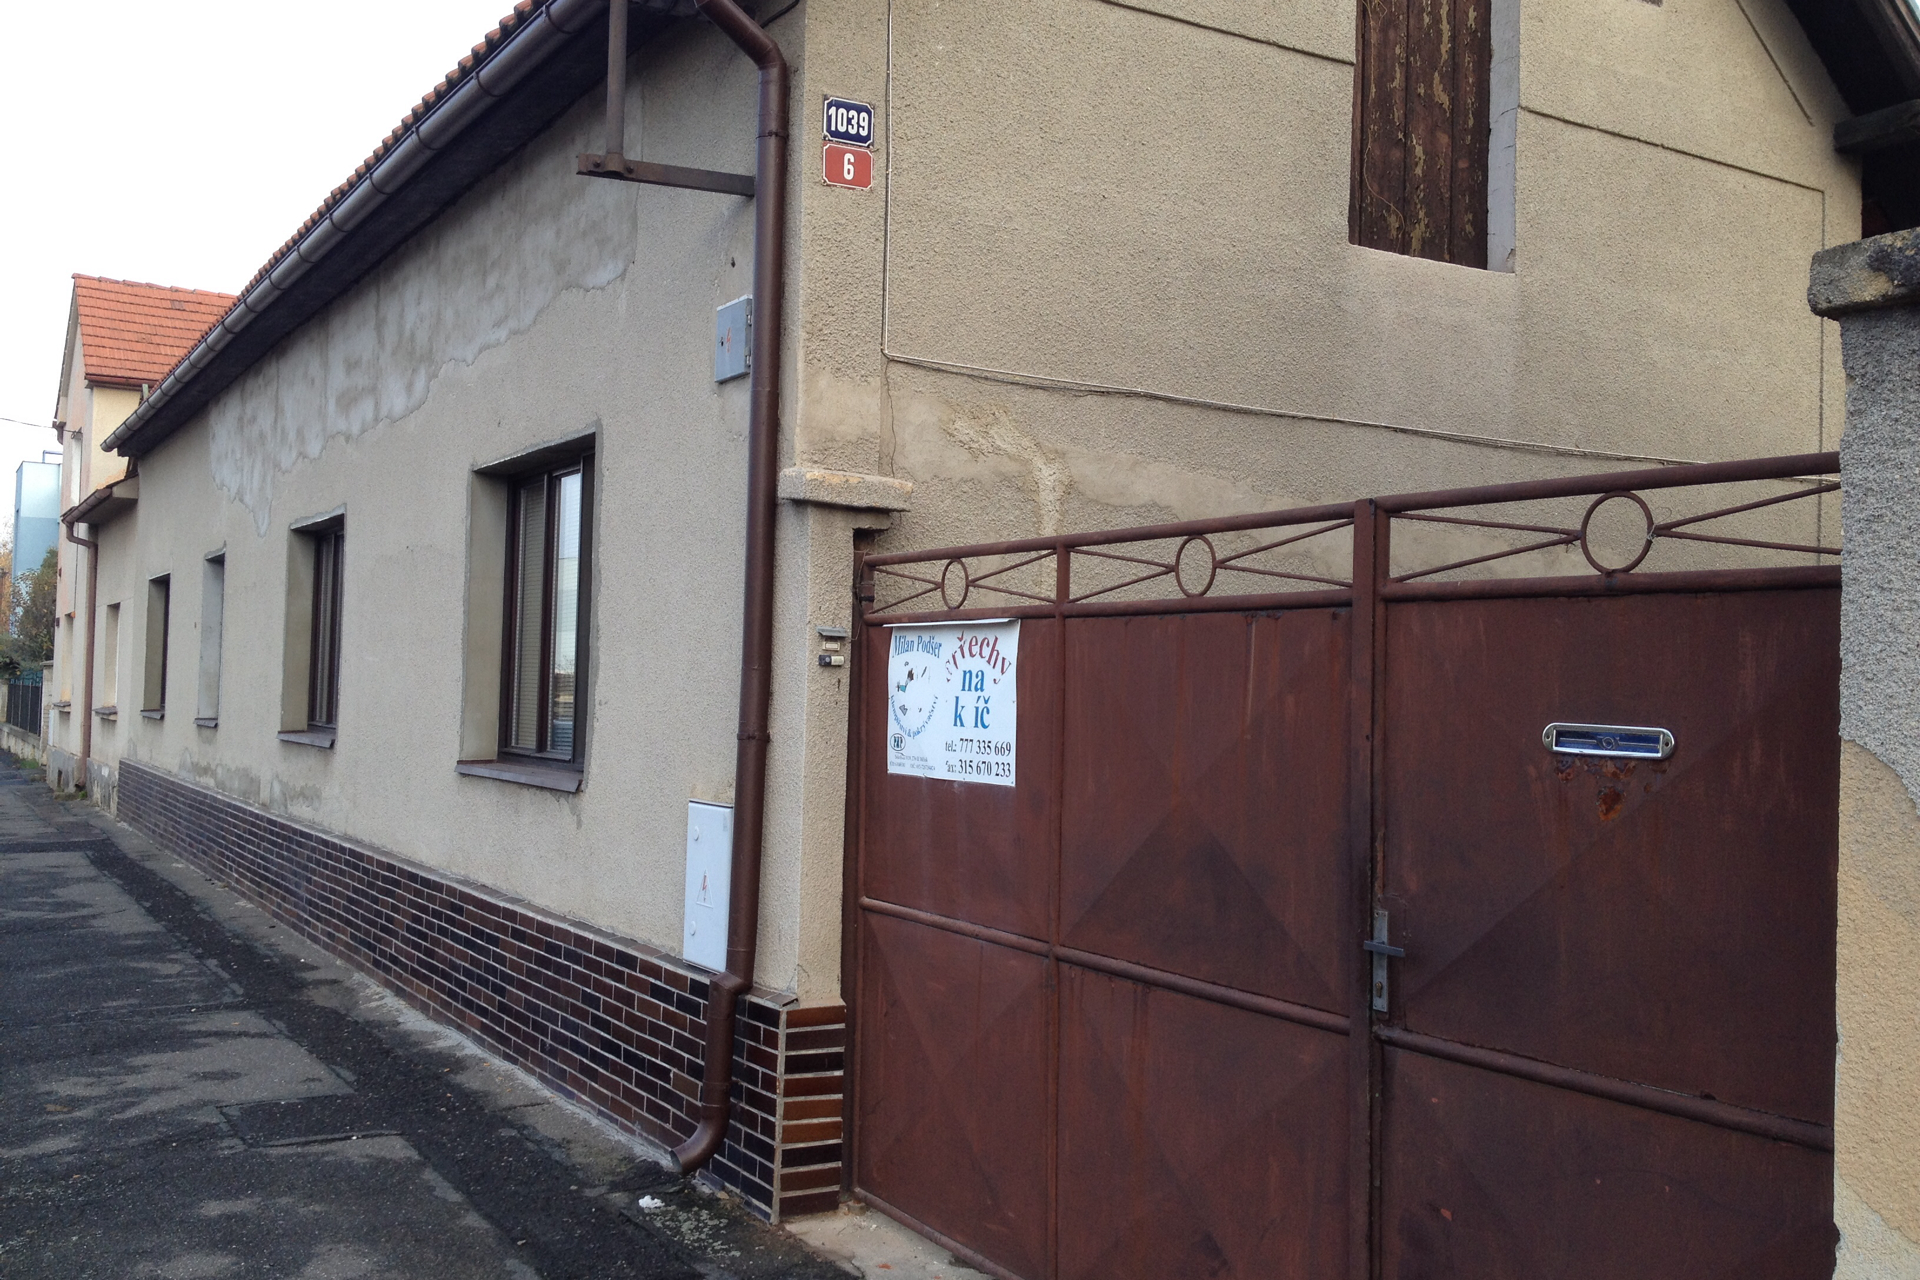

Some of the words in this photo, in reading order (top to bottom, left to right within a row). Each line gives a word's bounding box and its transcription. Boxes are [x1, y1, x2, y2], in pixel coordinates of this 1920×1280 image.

[828, 106, 869, 136] 1039
[843, 153, 855, 180] 6
[892, 635, 915, 658] Milan
[961, 669, 985, 692] na
[953, 695, 991, 729] kíč
[959, 738, 974, 753] 777
[976, 740, 992, 755] 335
[994, 741, 1011, 757] 669
[958, 759, 974, 775] 315
[976, 760, 992, 776] 670
[994, 761, 1011, 778] 233
